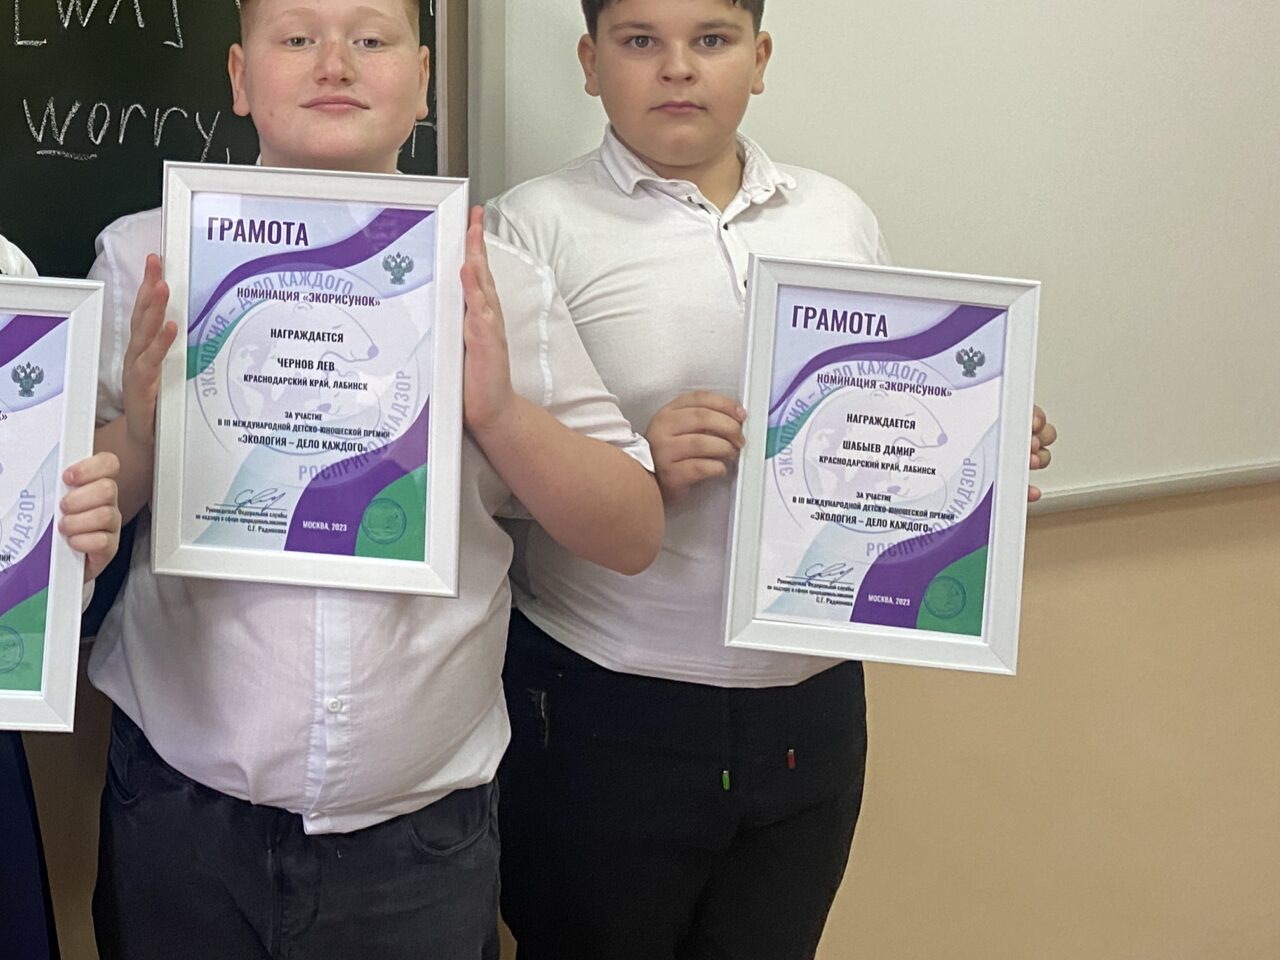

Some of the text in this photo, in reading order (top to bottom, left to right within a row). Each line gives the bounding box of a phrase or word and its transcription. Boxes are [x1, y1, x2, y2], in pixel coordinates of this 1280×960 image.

[207, 216, 309, 247] ГРАМОТА
[278, 271, 353, 295] КАЖДОГО
[237, 287, 381, 307] НОМИНАЦИЯ «ЭКОРИСУНОК»
[792, 305, 888, 338] ГРАМОТА
[270, 328, 344, 343] НАГРАЖДАЕТСЯ
[277, 358, 335, 371] ЧЕРНОВ ЛЕВ
[857, 361, 928, 385] КАЖДОГО
[243, 374, 368, 391] КРАСНОДАРСКИЙ КРАЙ, ЛАБИНСК
[817, 373, 952, 397] НОМИНАЦИЯ «ЭКОРИСУНОК»
[294, 412, 322, 421] УЧАСТИЕ
[846, 413, 916, 430] НАГРАЖДАЕТСЯ
[233, 420, 291, 432] МЕЖДУНАРОДНОЙ
[363, 429, 390, 438] ПРЕМИИ
[238, 434, 287, 447] «ЭКОЛОГИЯ
[296, 438, 320, 450] ДЕЛО
[322, 440, 368, 453] КАЖДОГО»
[843, 440, 915, 457] ШАБЫЕВ ДАМИР
[819, 455, 936, 475] КРАСНОДАРСКИЙ КРАЙ, ЛАБИНСК
[866, 493, 891, 502] УЧАСТИЕ
[806, 497, 861, 511] МЕЖДУНАРОДНОЙ
[929, 511, 955, 520] ПРЕМИИ
[302, 521, 347, 532] МОСКВА, 2023
[810, 512, 857, 525] «ЭКОЛОГИЯ
[865, 517, 888, 529] ДЕЛО
[889, 519, 933, 533] КАЖДОГО»
[868, 594, 910, 606] МОСКВА, 2023
